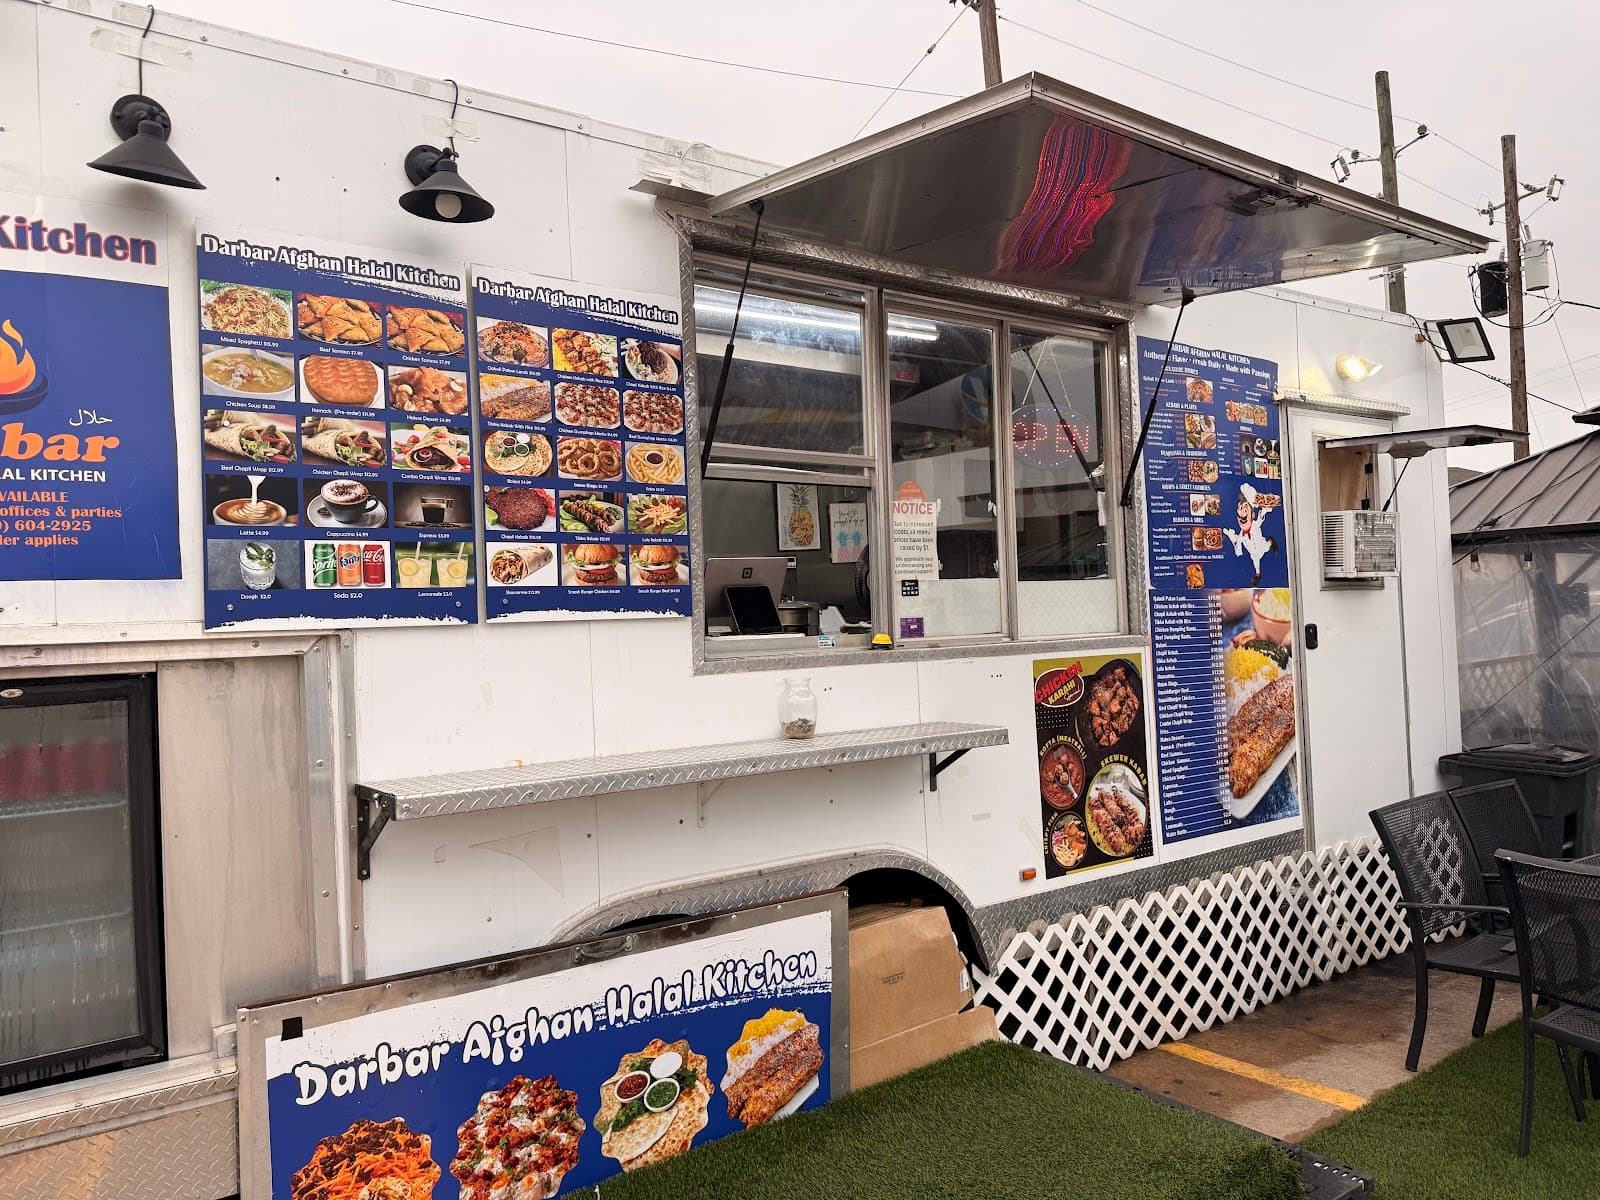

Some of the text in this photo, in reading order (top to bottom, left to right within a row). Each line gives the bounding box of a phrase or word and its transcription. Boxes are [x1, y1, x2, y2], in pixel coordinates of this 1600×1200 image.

[201, 234, 461, 291] Darbar Afghan Halal Kitchen
[477, 277, 679, 324] Darbar Afghan Halal Kitchen
[237, 338, 263, 347] Spaghetti
[1172, 354, 1189, 363] Flavor
[1192, 357, 1208, 367] Fresh
[1208, 358, 1221, 370] Daily
[1225, 362, 1240, 372] Made
[1190, 347, 1211, 358] AFGHAN
[1211, 350, 1228, 361] HALAL
[1228, 353, 1251, 365] KITCHEN
[225, 400, 247, 408] Chicken
[69, 408, 113, 427] حلال
[1011, 420, 1090, 454] OPEN
[0, 468, 106, 482] AL KITCHEN
[0, 505, 122, 519] offices & parties
[892, 502, 933, 515] NOTICE
[15, 520, 92, 532] 604-2925
[0, 534, 79, 548] er applies
[1034, 661, 1083, 703] CHICKEN
[1048, 679, 1076, 705] KARAHI
[1039, 737, 1056, 757] KOFTA
[1100, 753, 1148, 786] SKEWER KABAB
[293, 949, 819, 1107] Darbar Afghan Halal Kitchen
